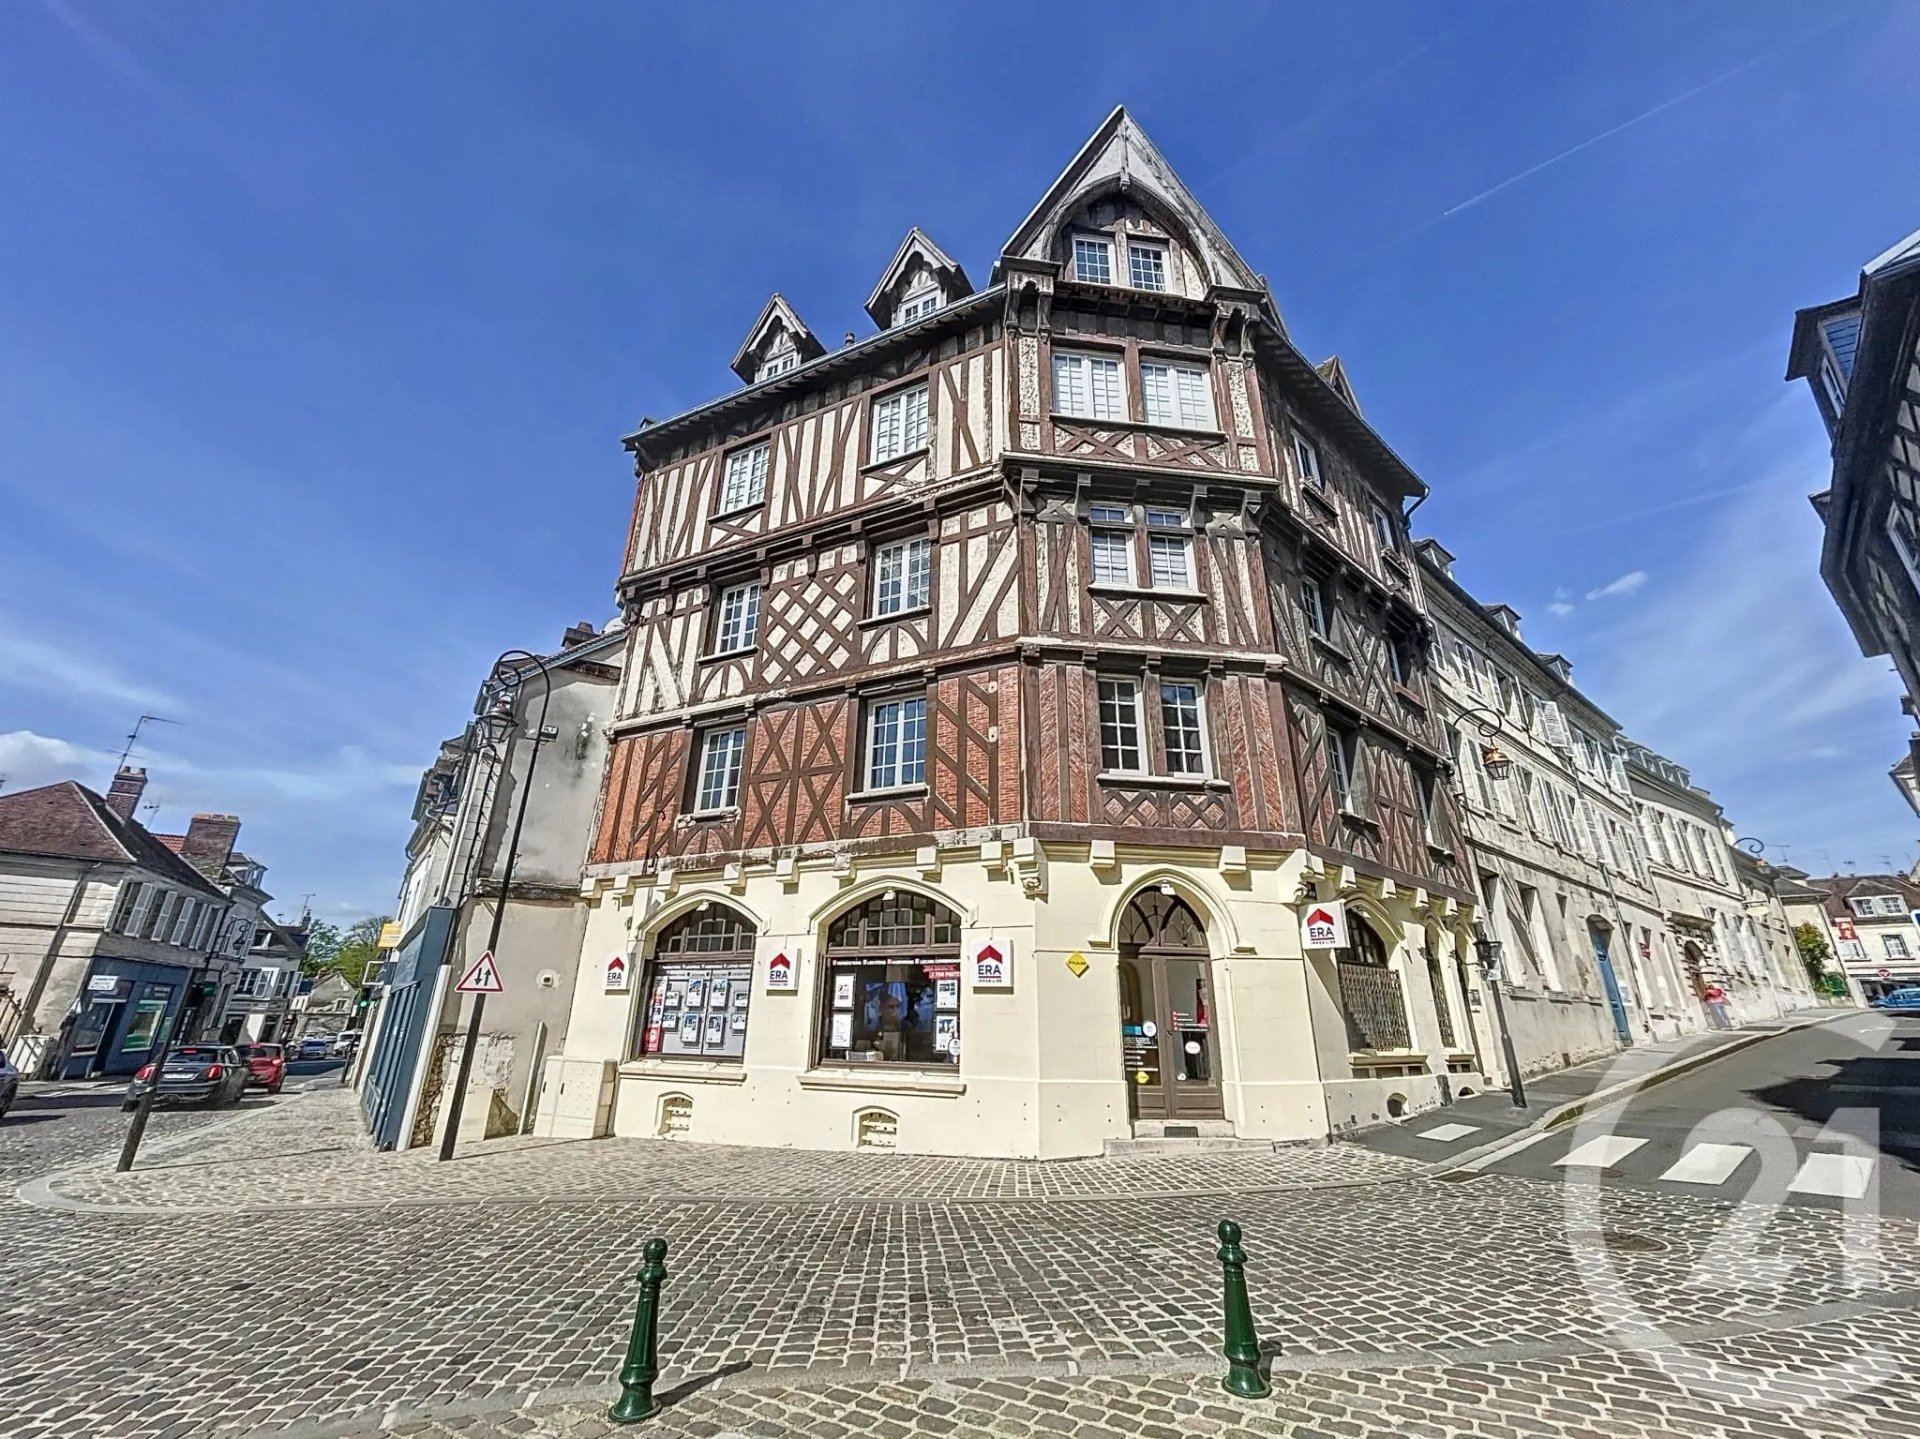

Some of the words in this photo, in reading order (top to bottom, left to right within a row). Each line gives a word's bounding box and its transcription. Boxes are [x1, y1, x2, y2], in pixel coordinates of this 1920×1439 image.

[1309, 927, 1334, 937] ERA
[978, 964, 1002, 975] ERA
[607, 972, 622, 981] ERA
[769, 970, 789, 980] ERA
